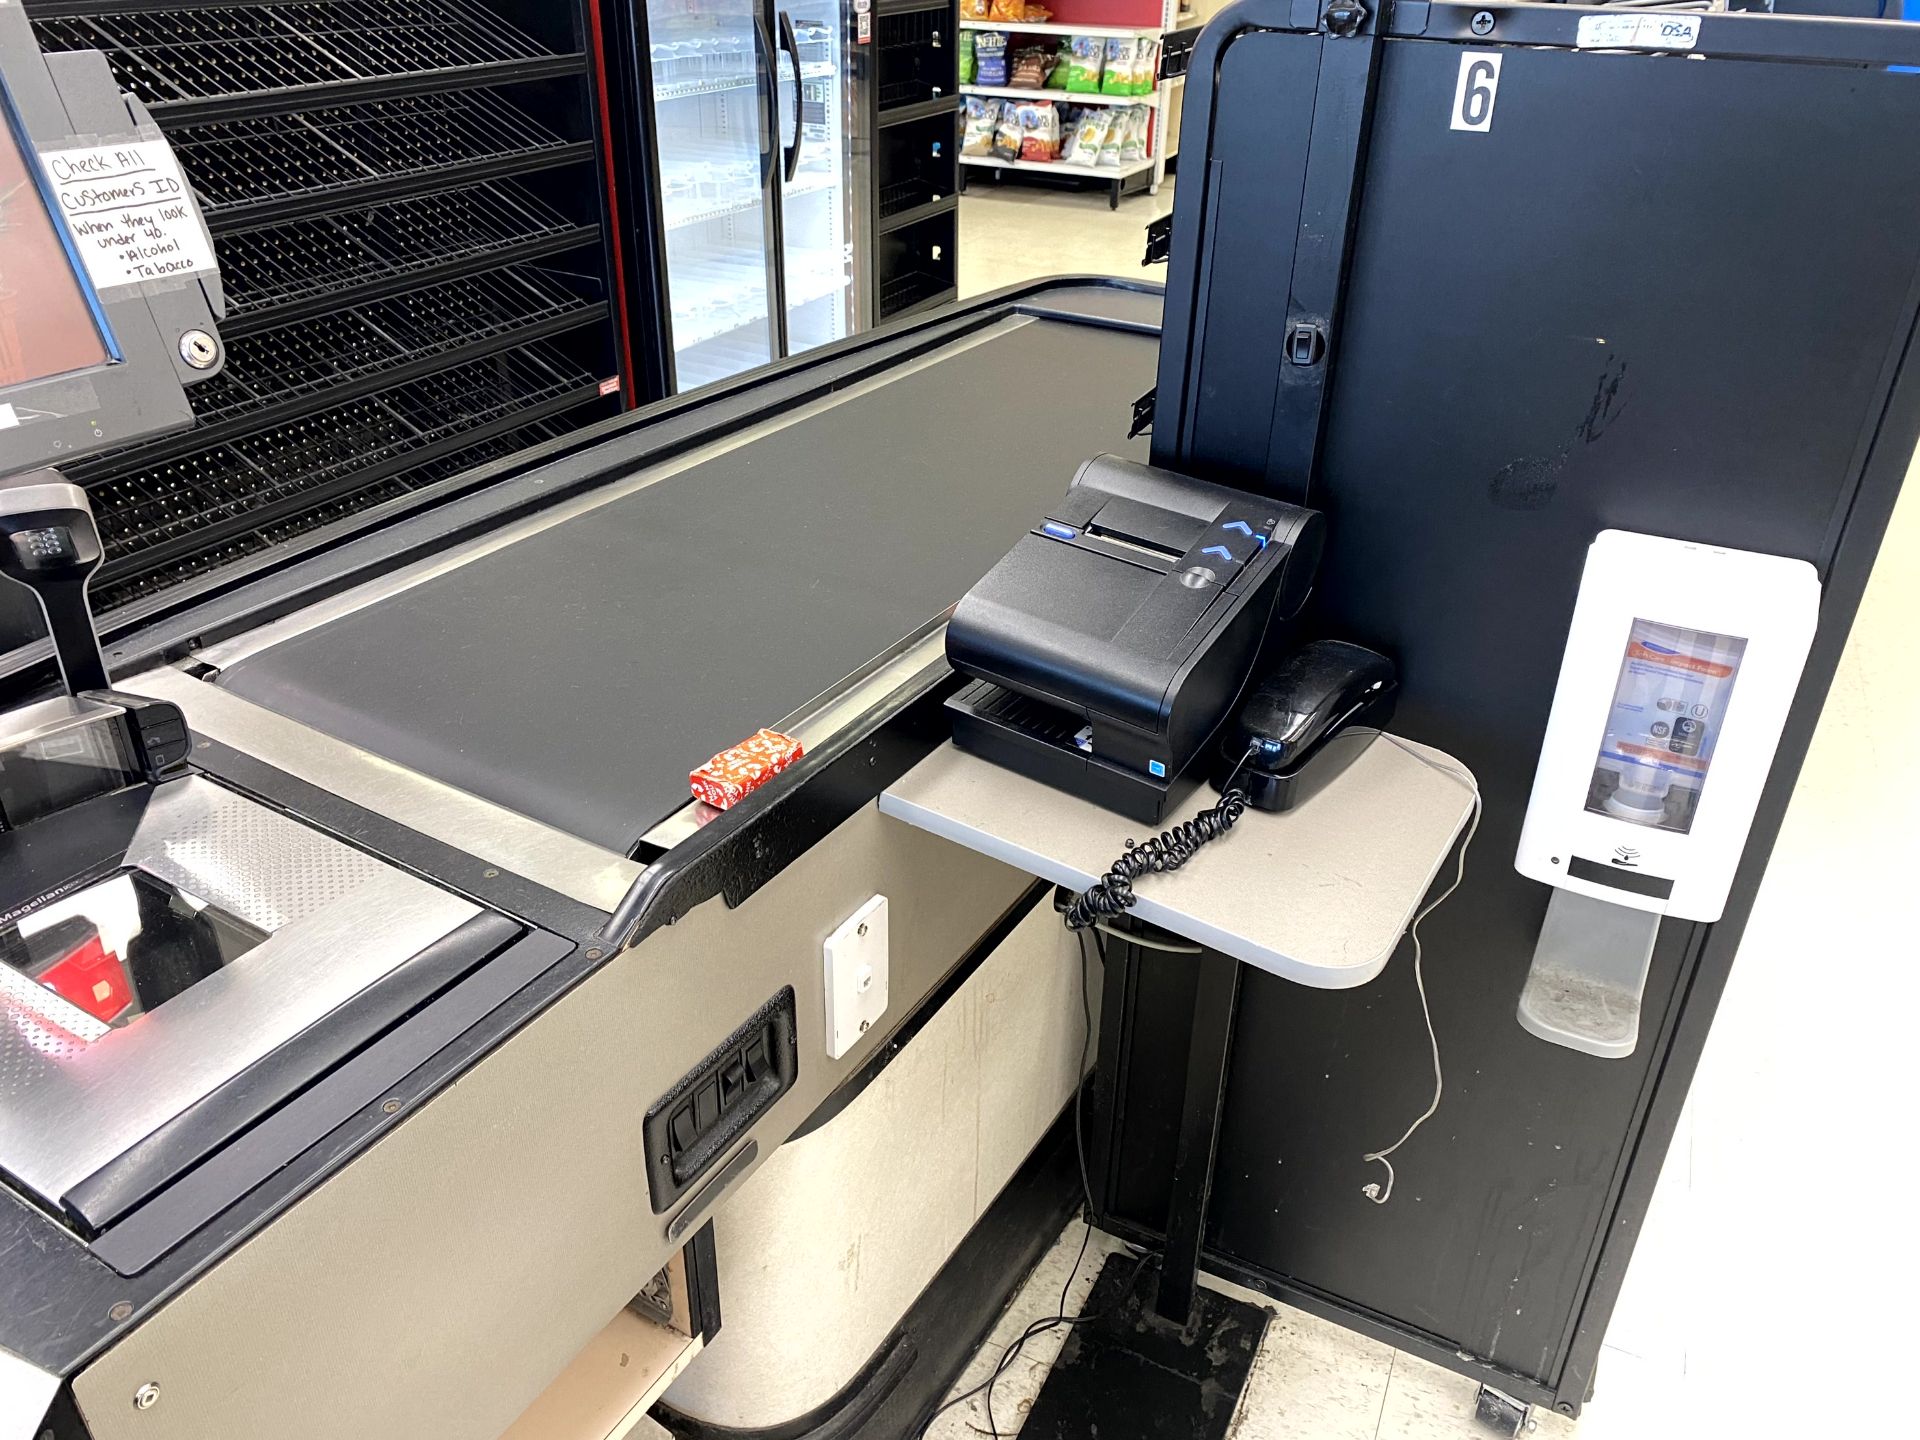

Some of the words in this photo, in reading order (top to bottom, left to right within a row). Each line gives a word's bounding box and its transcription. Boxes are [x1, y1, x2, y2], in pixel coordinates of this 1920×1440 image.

[1462, 60, 1495, 125] 6
[52, 154, 112, 180] Check
[115, 149, 145, 168] All
[149, 177, 180, 194] ID
[73, 220, 114, 236] When
[121, 212, 157, 231] they
[158, 205, 188, 221] look
[97, 233, 136, 248] under
[1652, 725, 1668, 736] NSF
[0, 887, 64, 924] Magellan
